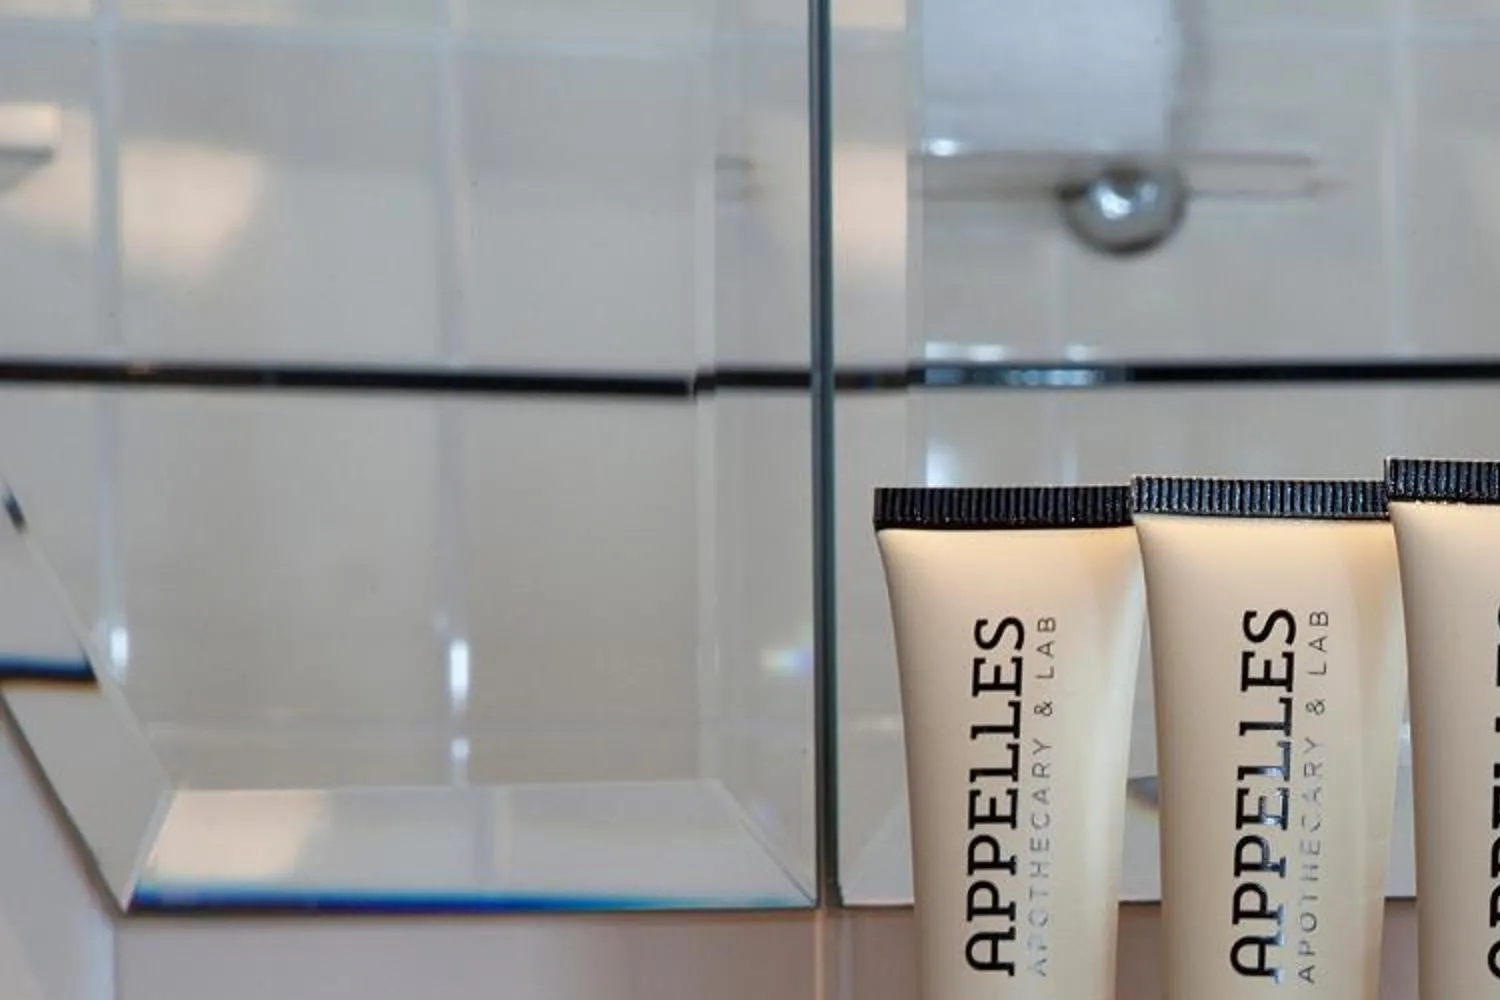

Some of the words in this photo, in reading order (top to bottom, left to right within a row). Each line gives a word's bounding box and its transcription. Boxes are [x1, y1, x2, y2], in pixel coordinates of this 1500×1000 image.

[1034, 701, 1054, 717] &
[1035, 615, 1056, 680] LAB
[1306, 698, 1326, 715] &
[1308, 610, 1329, 676] LAB
[965, 615, 1025, 977] APPELLES
[1028, 737, 1054, 977] APOTHECARY
[1230, 608, 1297, 984] APPELLES
[1298, 736, 1324, 984] APOTHECARY
